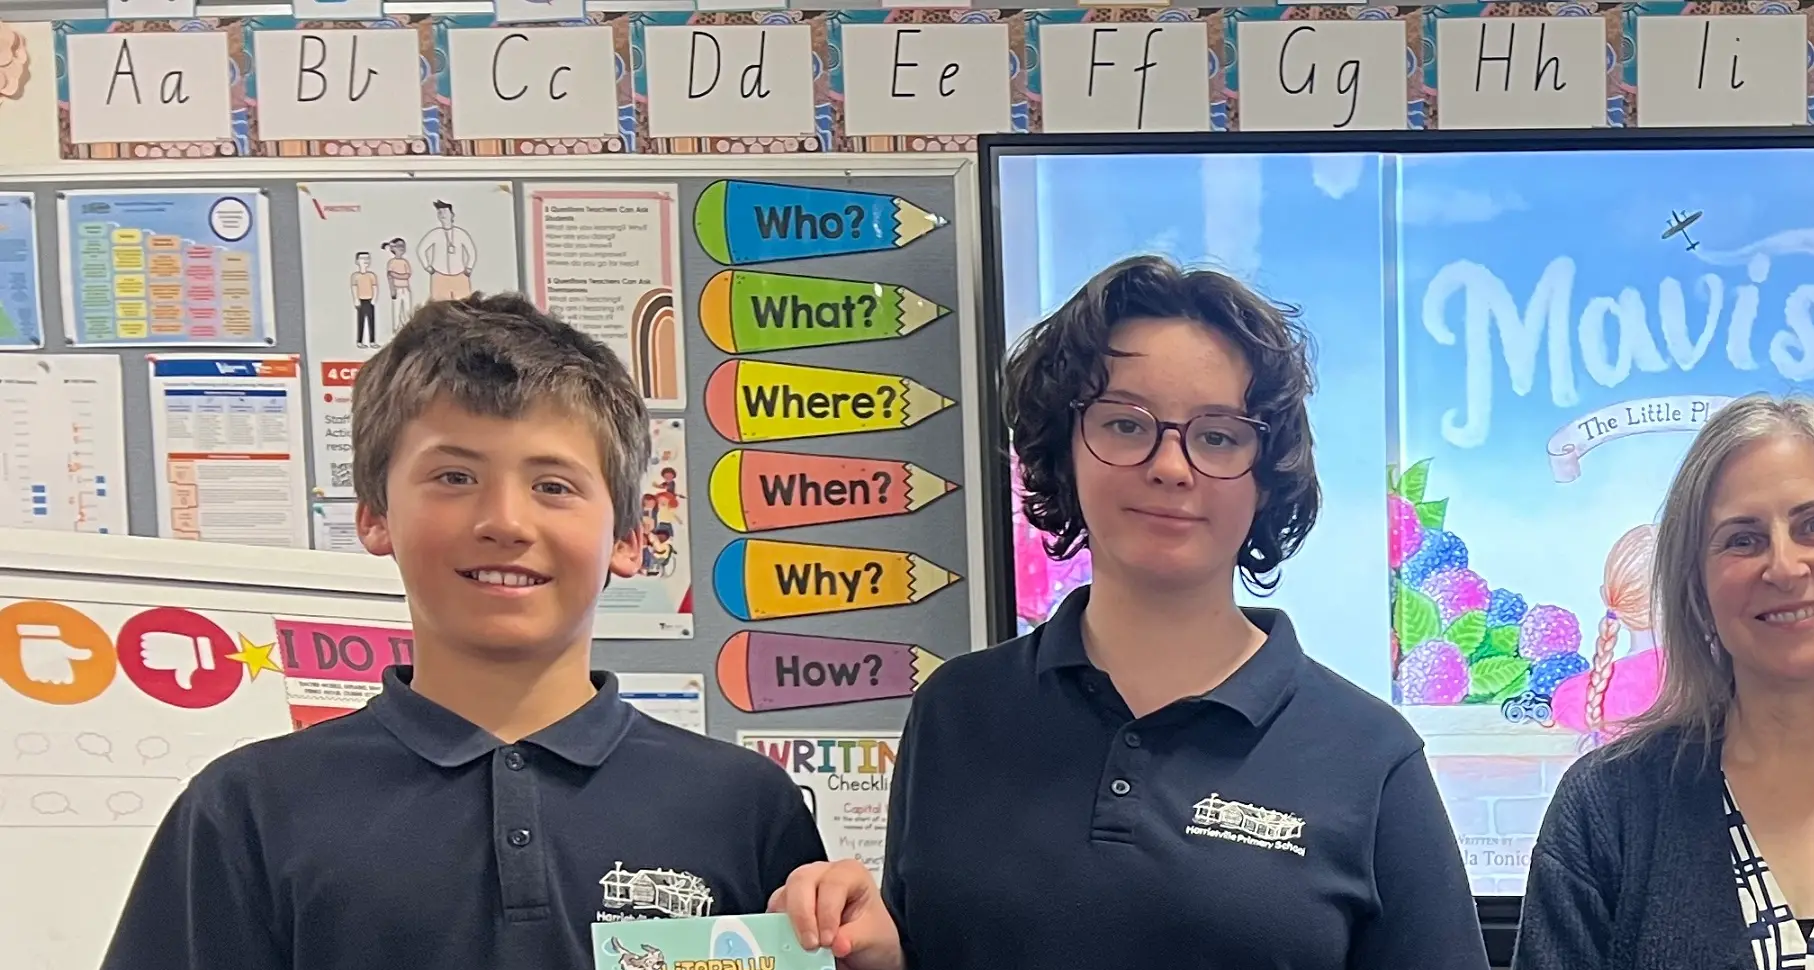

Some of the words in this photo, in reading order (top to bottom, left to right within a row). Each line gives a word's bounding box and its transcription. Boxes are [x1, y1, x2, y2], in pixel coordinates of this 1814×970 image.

[755, 205, 865, 240] Who?
[751, 295, 878, 330] What?
[743, 385, 896, 420] Where?
[1578, 413, 1618, 441] The
[1626, 403, 1684, 426] Little
[760, 471, 892, 507] When?
[774, 561, 883, 602] Why?
[312, 631, 374, 671] DO
[775, 654, 883, 687] How?
[1186, 825, 1237, 842] Harrietville
[1237, 835, 1274, 849] Primary
[1274, 841, 1306, 857] School
